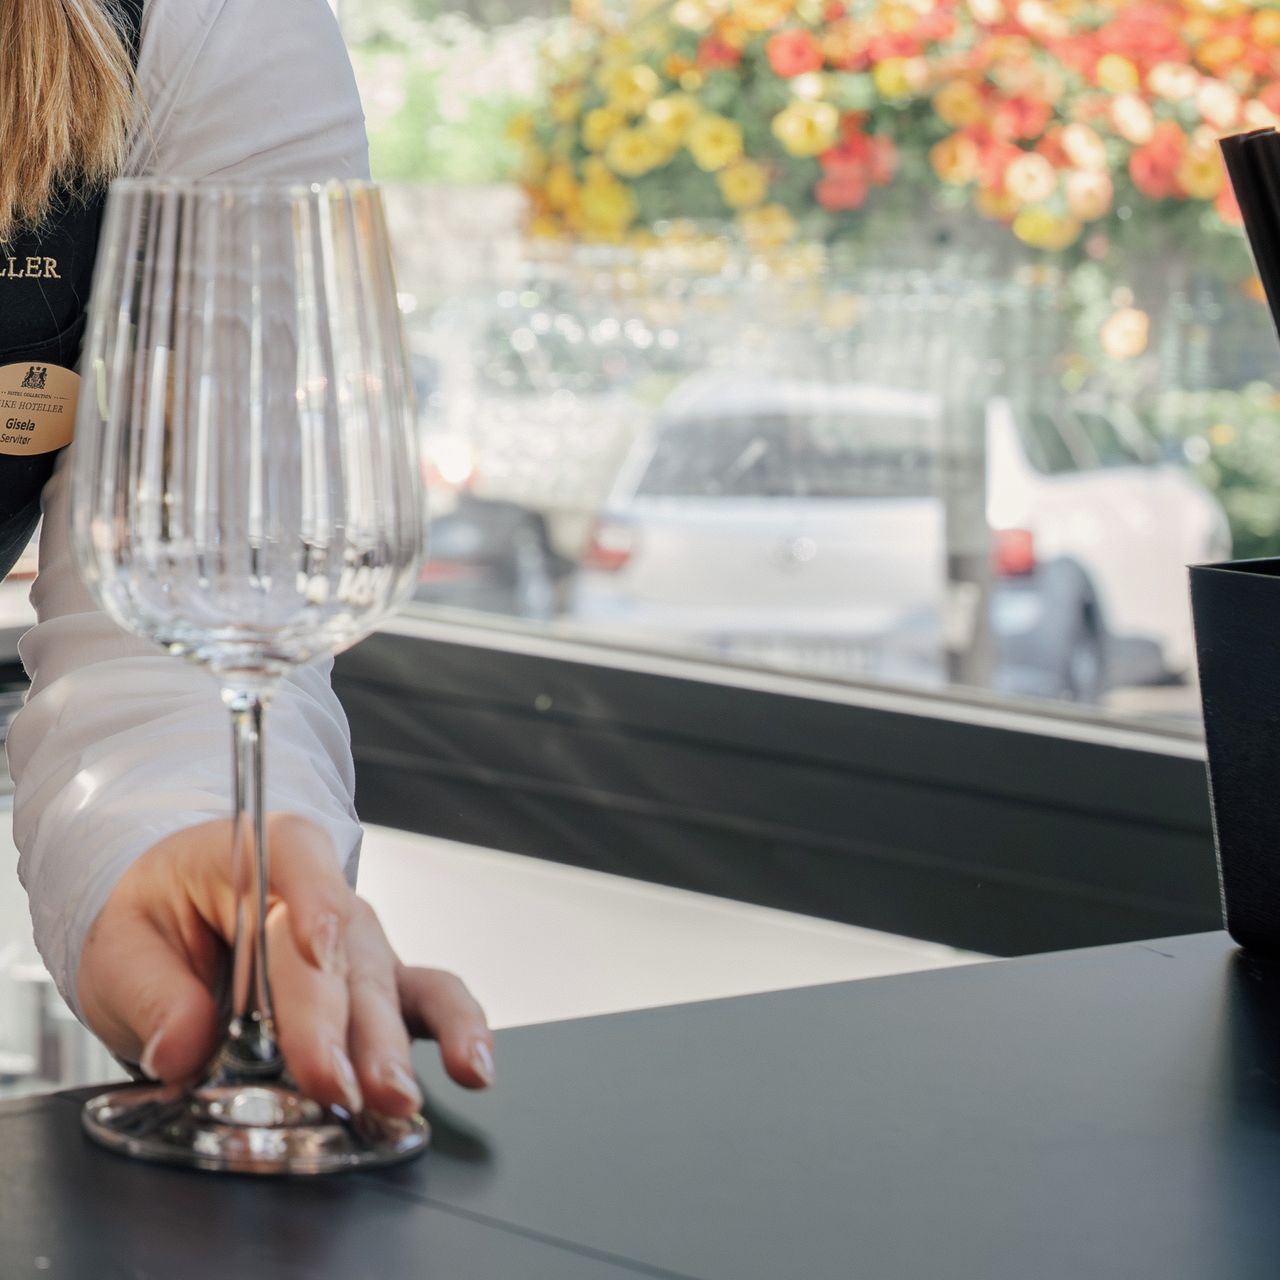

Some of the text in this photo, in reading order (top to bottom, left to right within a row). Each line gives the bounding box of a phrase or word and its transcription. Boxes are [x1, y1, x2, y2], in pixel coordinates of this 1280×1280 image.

[24, 392, 52, 400] COLLECTION
[18, 401, 64, 414] HOTELLER
[5, 418, 36, 432] Gisela
[0, 433, 32, 445] Servitør
